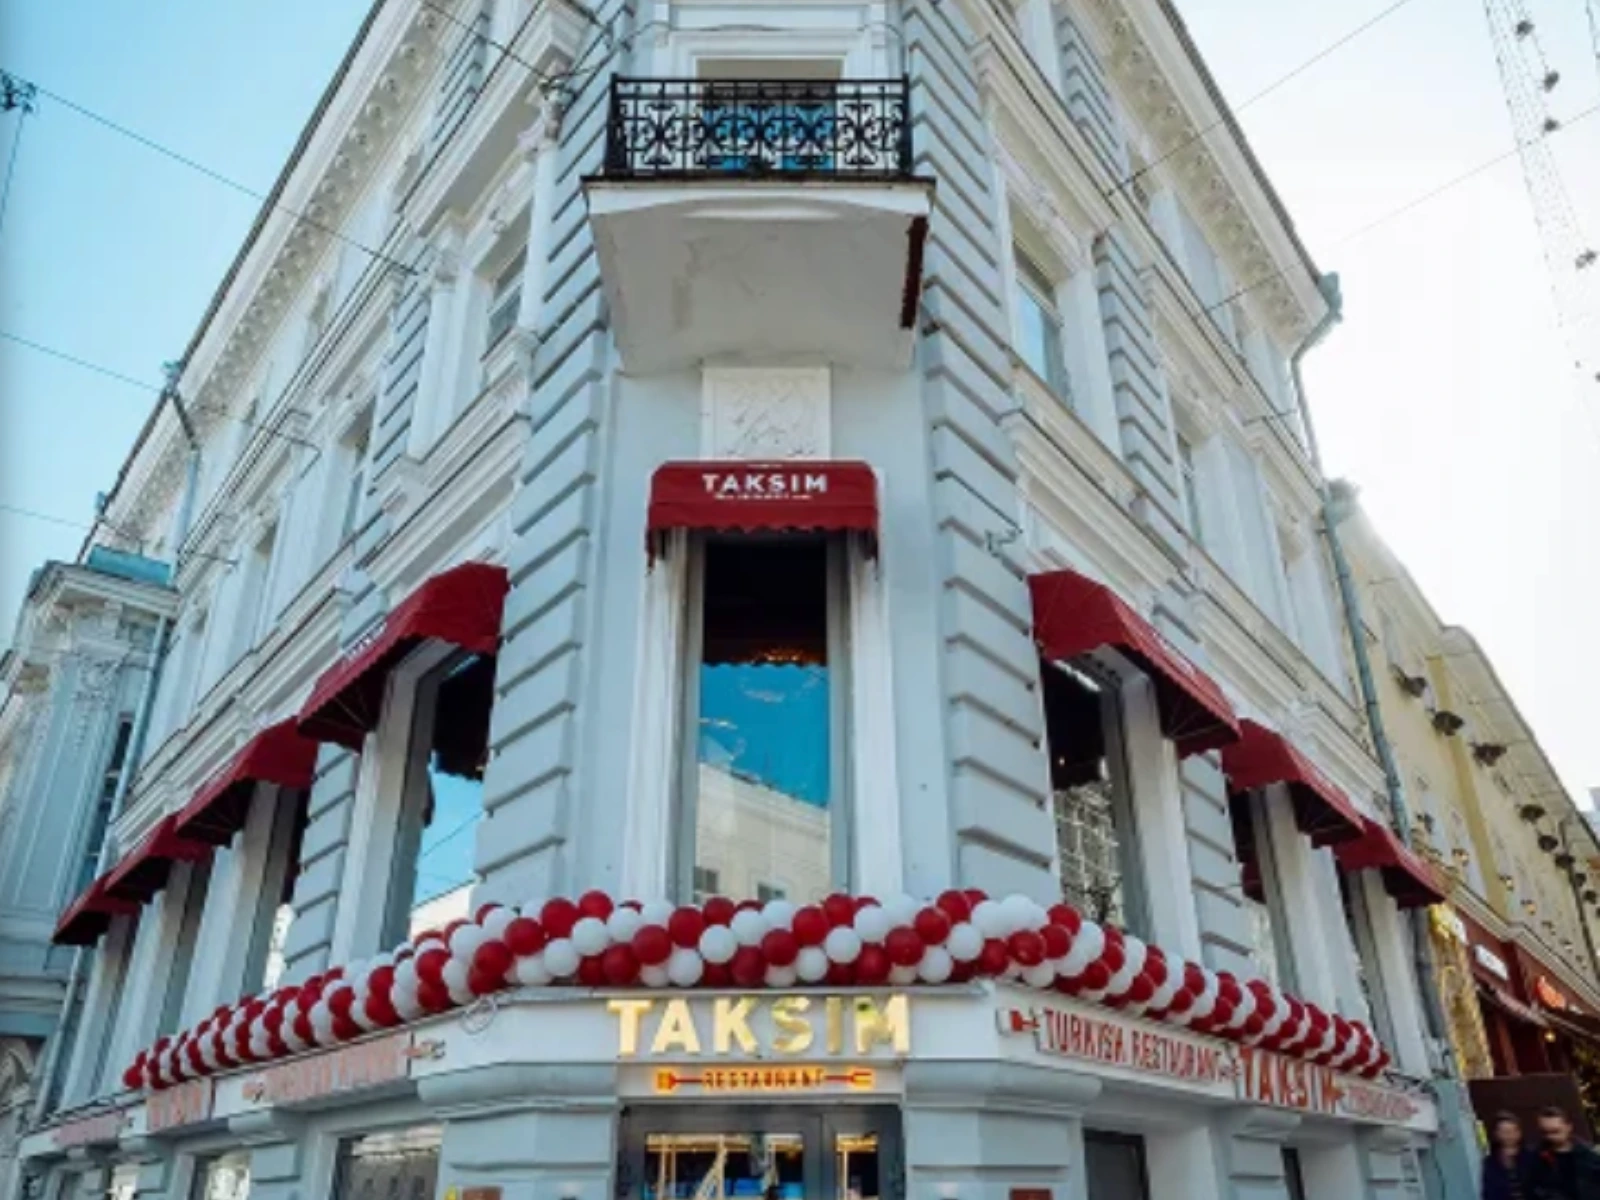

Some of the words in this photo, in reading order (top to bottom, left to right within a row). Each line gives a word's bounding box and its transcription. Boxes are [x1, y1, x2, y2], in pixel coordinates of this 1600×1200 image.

[703, 473, 827, 493] TAKSIM
[606, 996, 910, 1056] TAKSIM
[703, 1070, 824, 1088] RESTAURANT
[1238, 1045, 1337, 1113] TAKSIM
